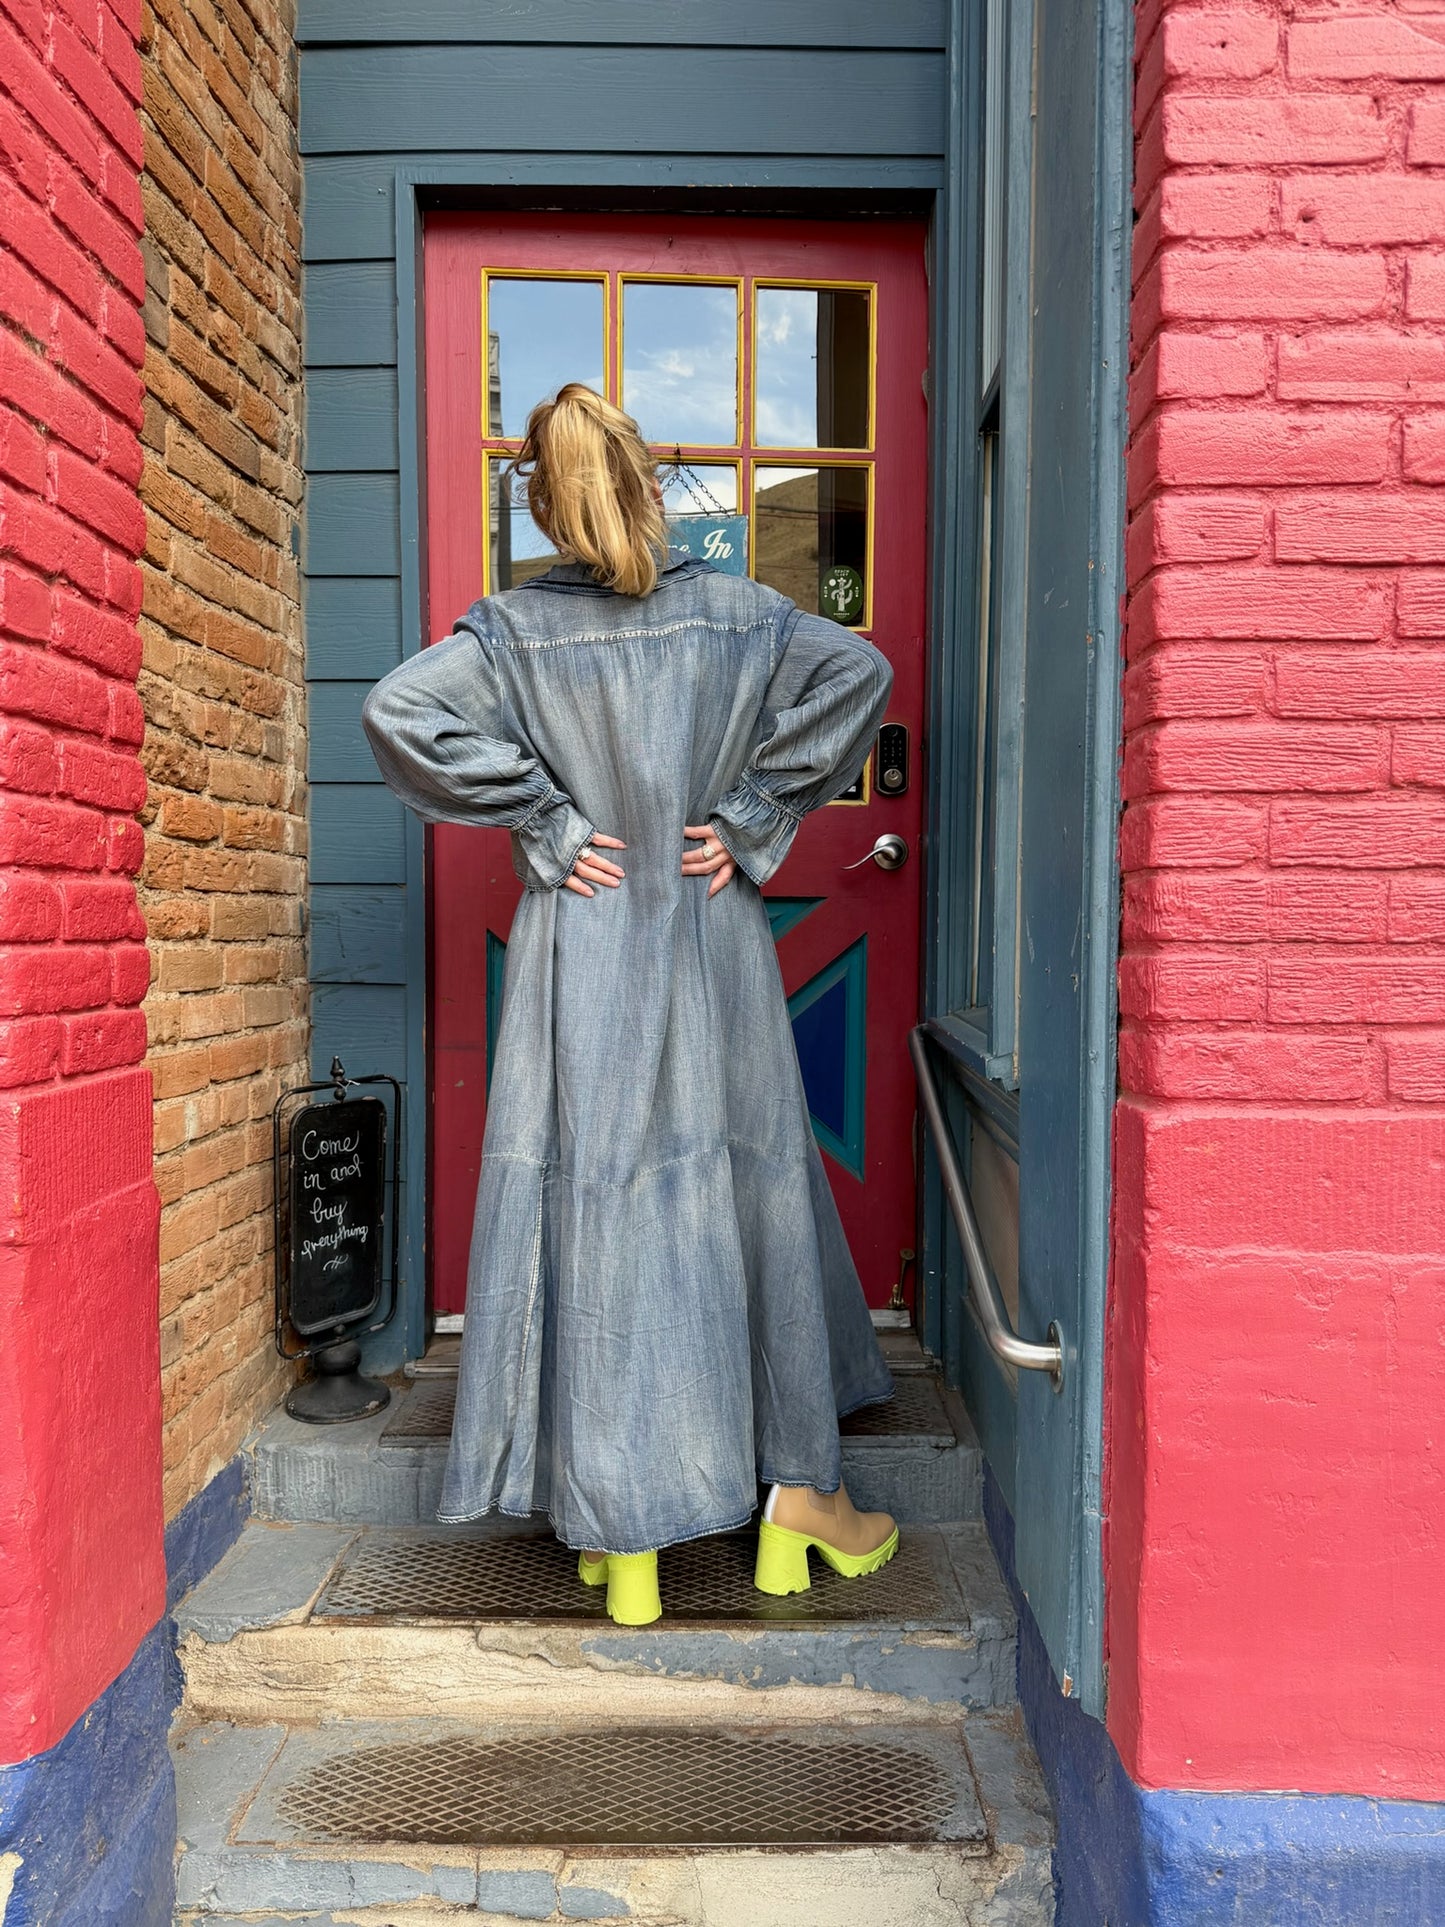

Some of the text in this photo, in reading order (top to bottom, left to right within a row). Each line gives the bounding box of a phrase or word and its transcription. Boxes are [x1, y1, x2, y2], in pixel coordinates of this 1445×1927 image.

[701, 529, 734, 560] In
[302, 1130, 360, 1161] Come
[303, 1153, 362, 1190] in and
[310, 1197, 348, 1226] buy
[301, 1223, 369, 1260] everything
